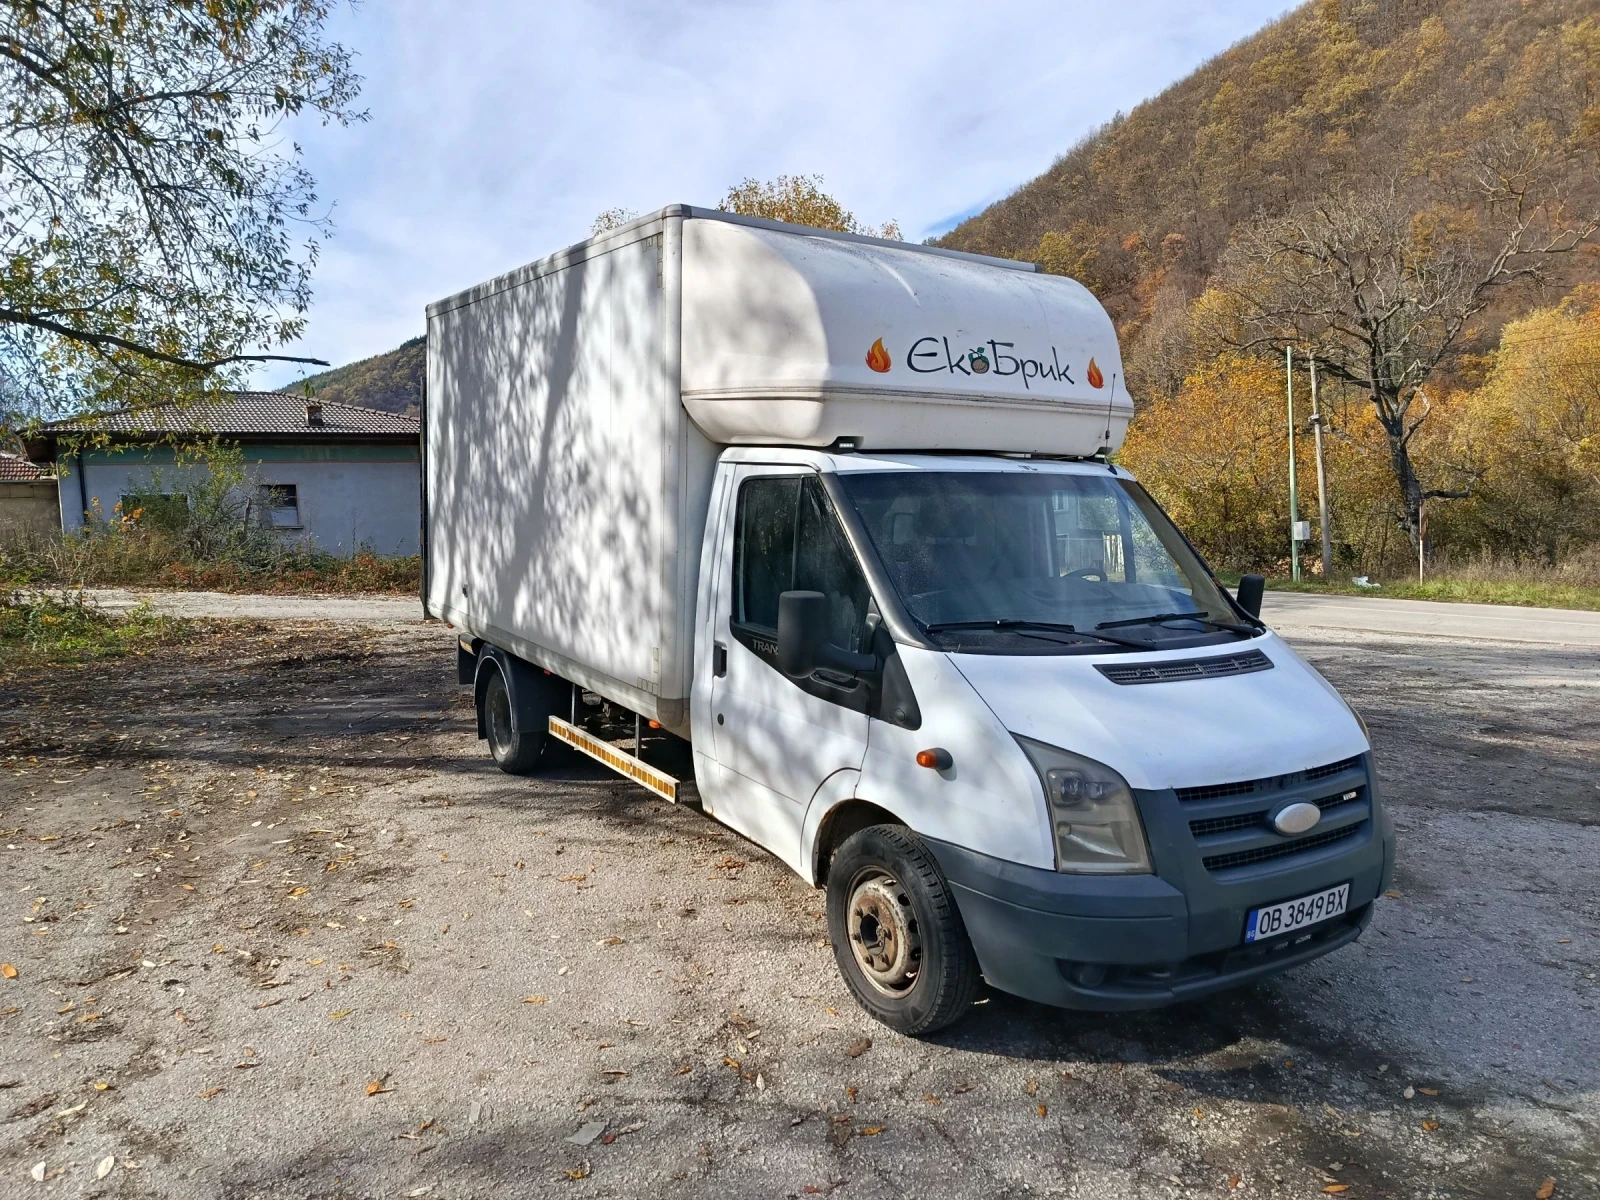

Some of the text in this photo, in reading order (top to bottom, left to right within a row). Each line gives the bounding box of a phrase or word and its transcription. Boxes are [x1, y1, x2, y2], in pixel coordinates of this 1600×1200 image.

[1285, 896, 1324, 928] 3849
[1325, 888, 1346, 916] BX
[1246, 930, 1255, 939] BG
[845, 977, 887, 1022] SAILUN
